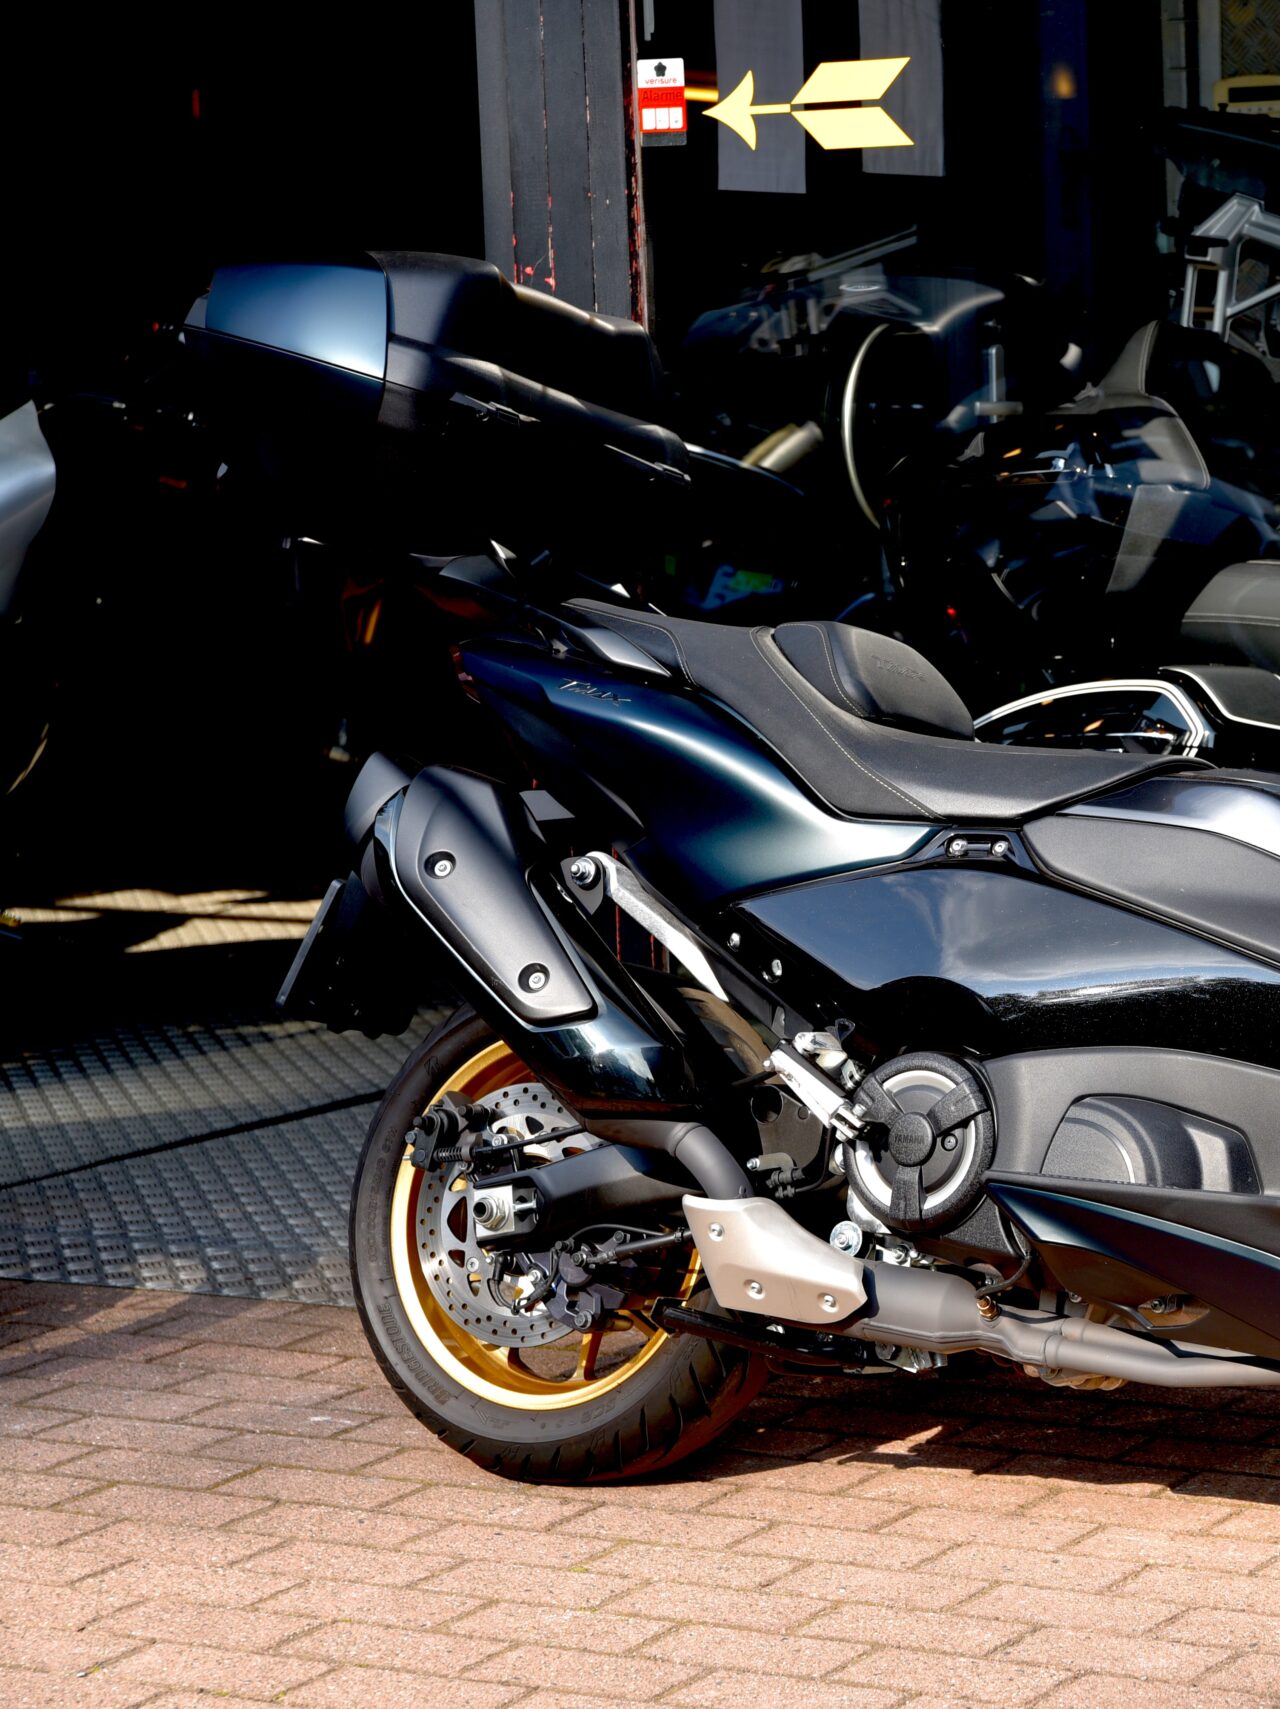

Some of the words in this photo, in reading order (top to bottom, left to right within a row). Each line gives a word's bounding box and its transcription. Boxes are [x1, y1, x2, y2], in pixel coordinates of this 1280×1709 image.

[644, 77, 678, 85] verisure
[642, 91, 682, 101] Alarme
[377, 1300, 451, 1406] BRIDGESTONE
